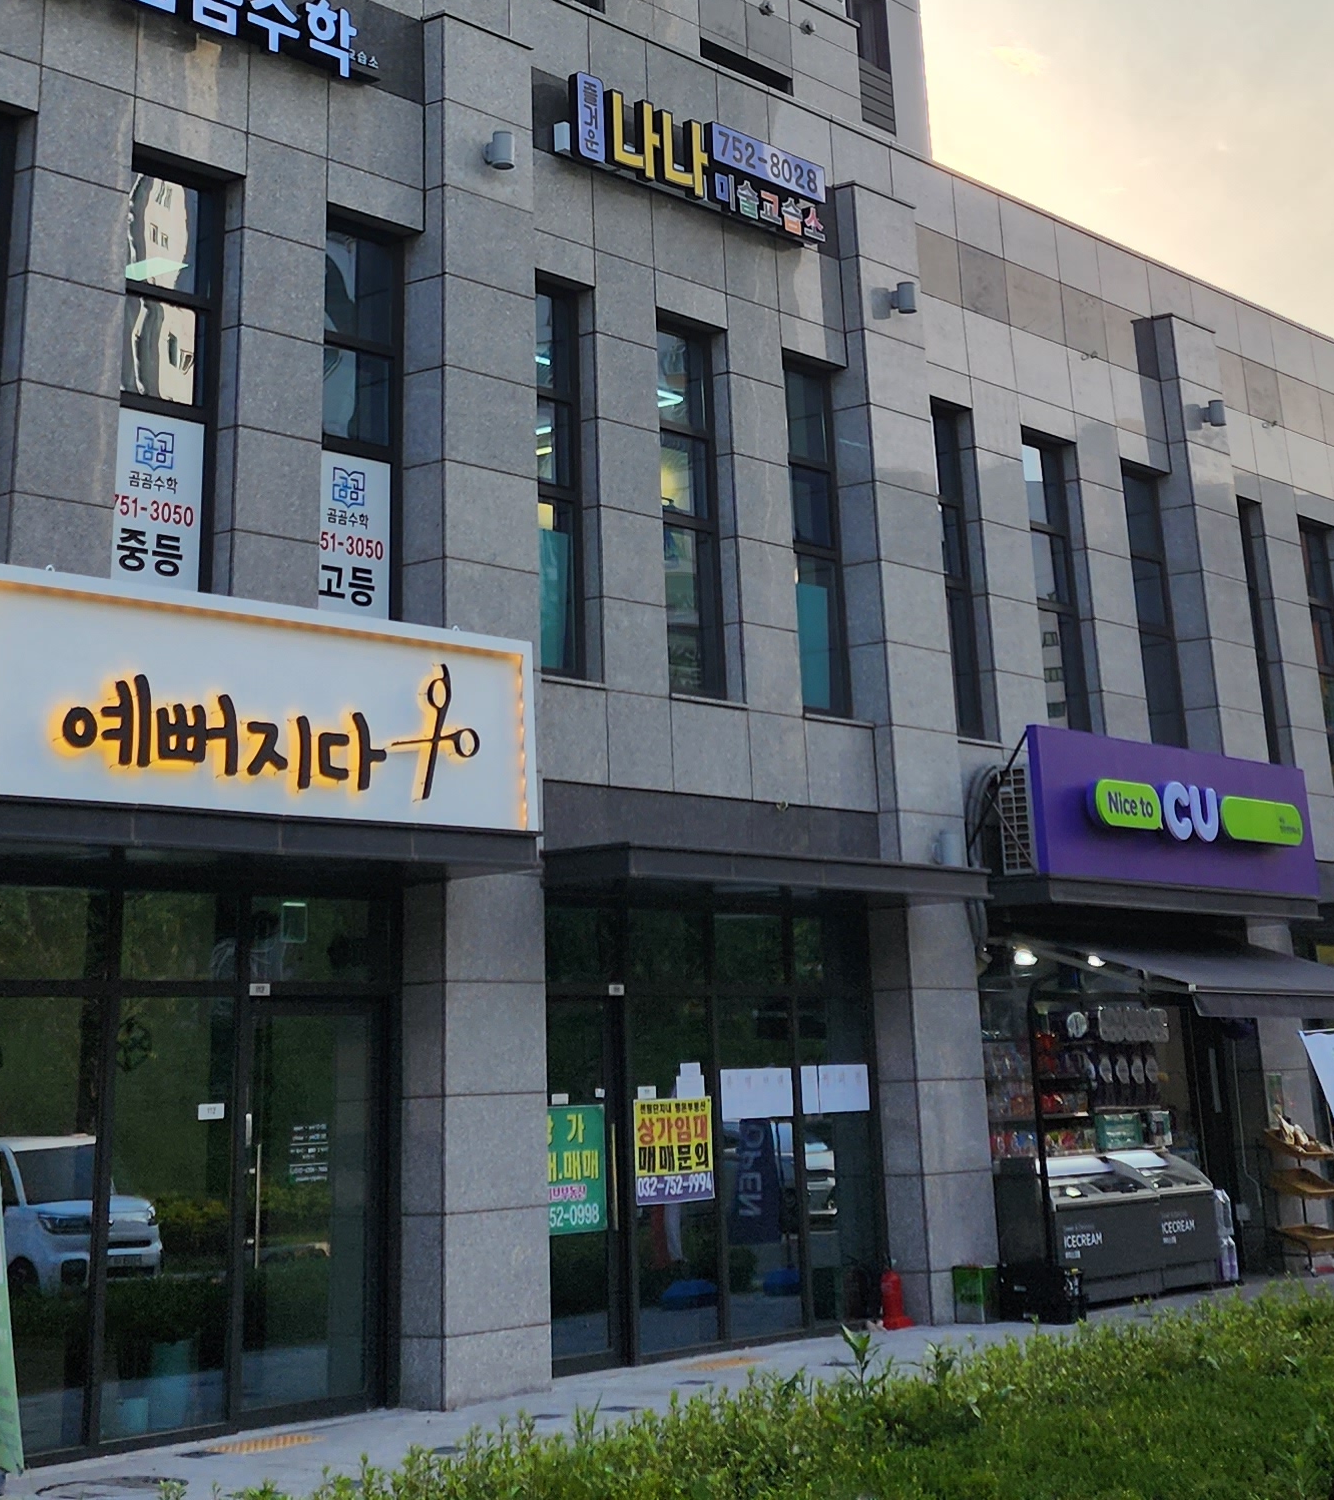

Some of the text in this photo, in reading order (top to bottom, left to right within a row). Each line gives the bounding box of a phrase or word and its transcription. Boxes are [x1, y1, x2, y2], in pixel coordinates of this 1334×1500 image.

[612, 90, 708, 197] 나나
[717, 129, 818, 193] 752-8028
[714, 172, 826, 242] 미술교습소
[128, 470, 178, 494] 곰곰수학
[327, 508, 369, 530] 곰곰수학
[117, 528, 183, 577] 중등
[318, 564, 375, 607] 고등
[63, 674, 387, 791] 예뻐지다
[1108, 791, 1154, 818] Nice to
[1163, 781, 1218, 842] CU
[638, 1115, 708, 1145] 상가임대
[638, 1142, 709, 1173] 매매문의
[638, 1172, 712, 1197] 032-752-9994
